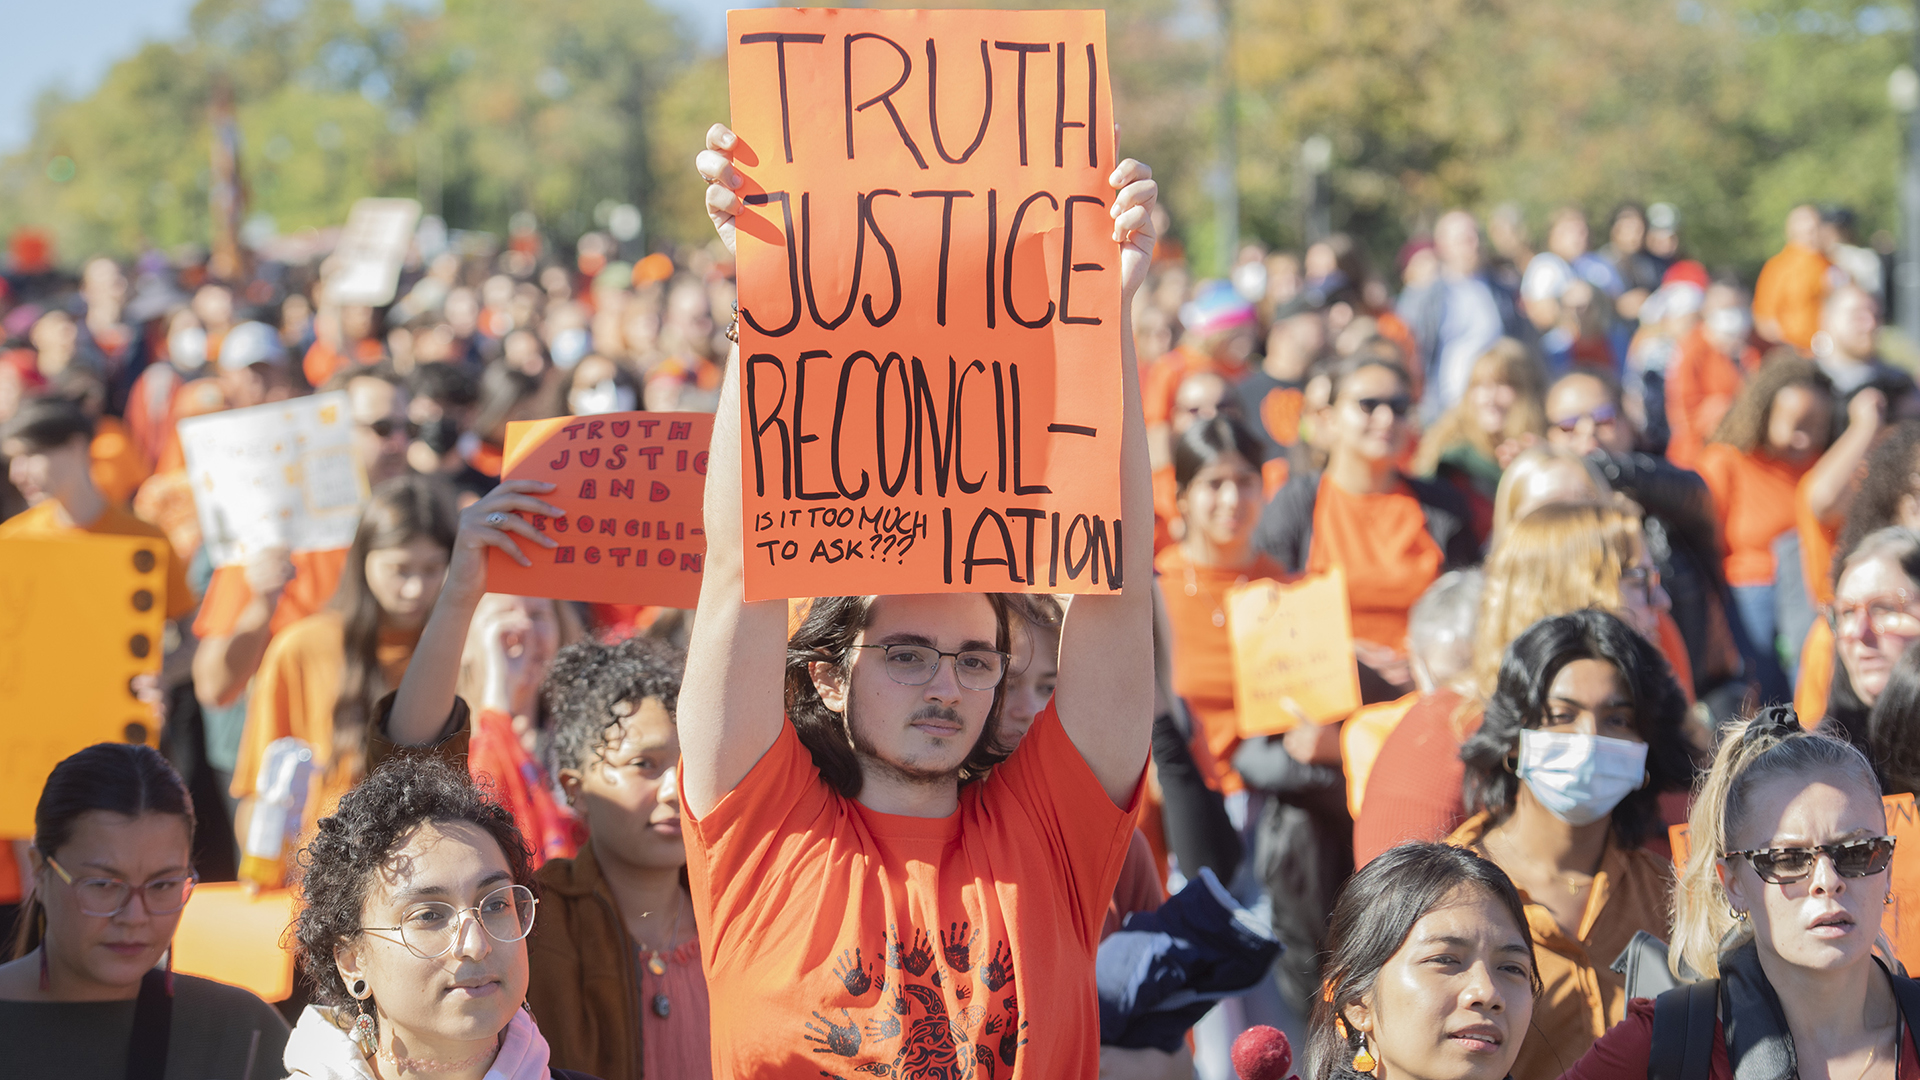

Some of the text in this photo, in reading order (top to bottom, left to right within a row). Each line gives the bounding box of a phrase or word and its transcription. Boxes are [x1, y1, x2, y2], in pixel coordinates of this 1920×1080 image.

[741, 33, 1098, 169] TRUTH
[741, 189, 1105, 337] JUSTICE
[562, 419, 692, 440] TRUTH
[747, 349, 1097, 501] RECONCIL-
[550, 444, 709, 475] JUSTIC
[578, 478, 671, 503] AND
[515, 512, 705, 541] ECONCILI-
[755, 505, 927, 540] IS IT TOO MUCH
[554, 545, 703, 573] ACTION
[756, 534, 914, 566] TO ASK???
[942, 507, 1123, 590] IATION
